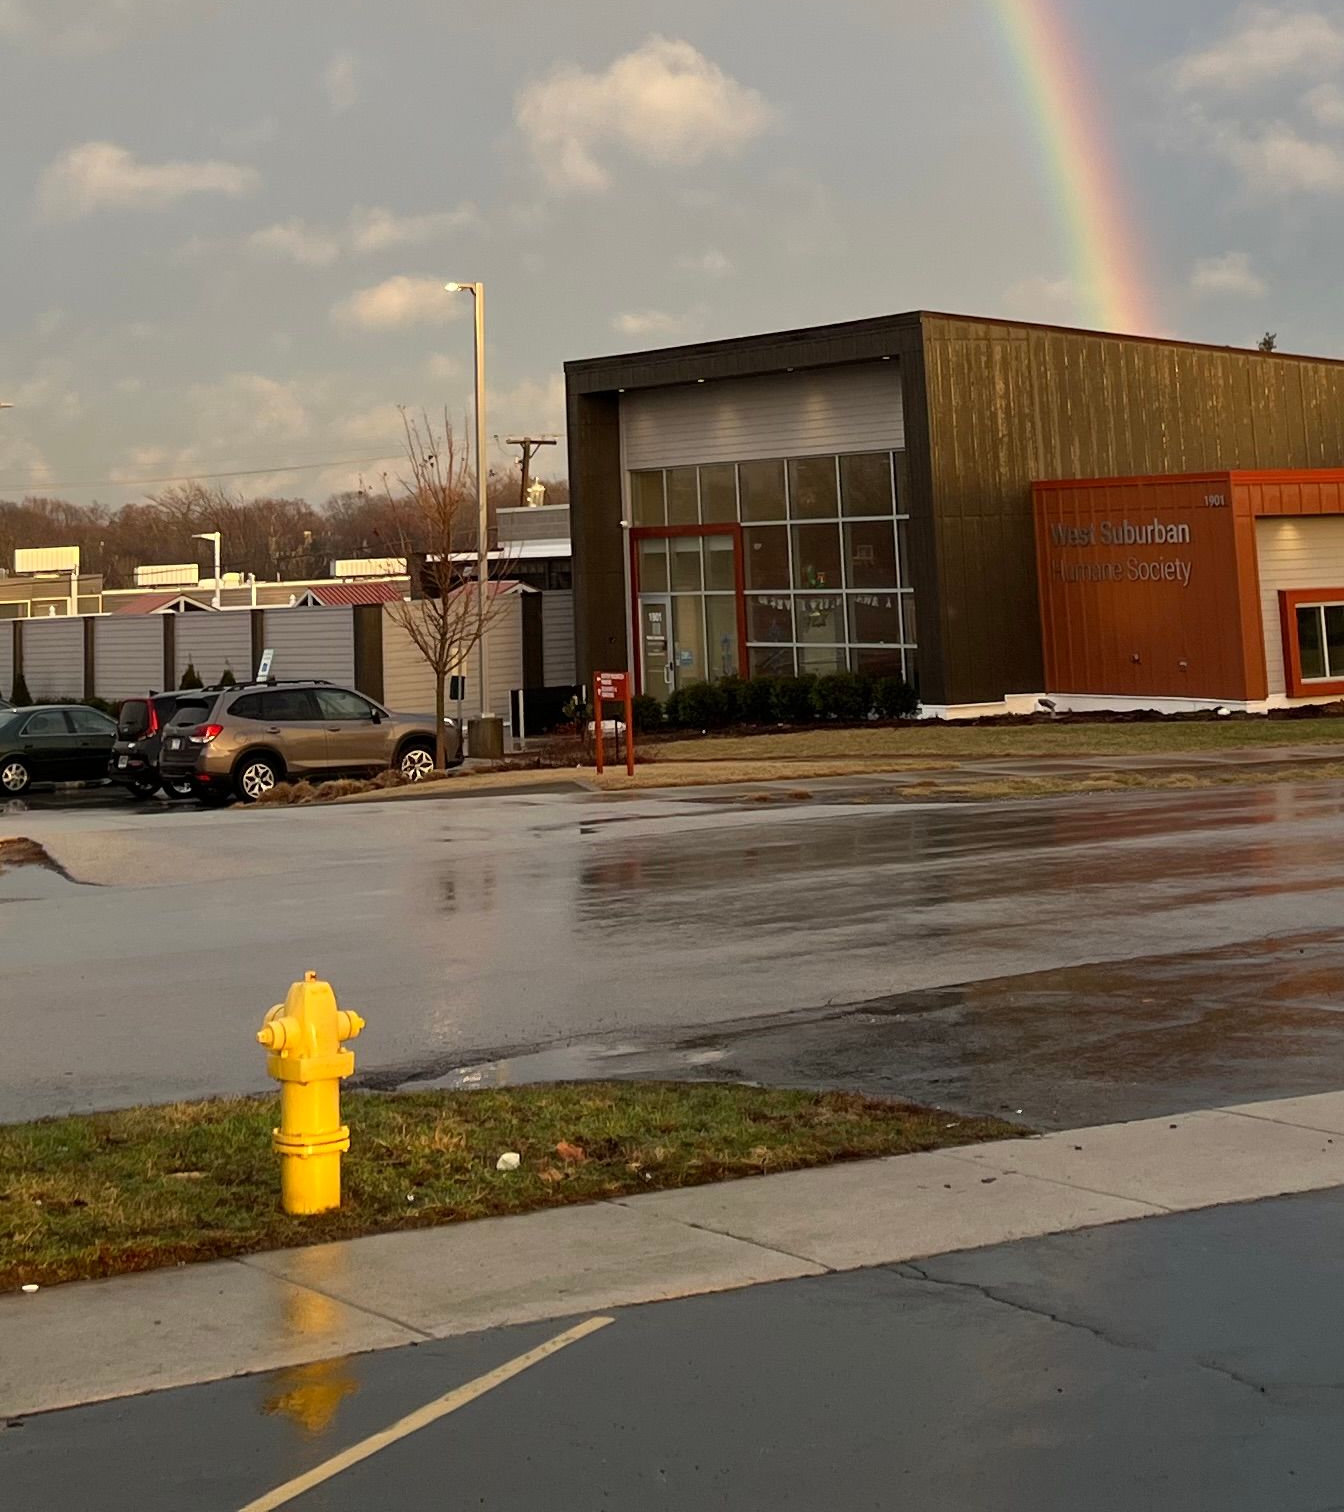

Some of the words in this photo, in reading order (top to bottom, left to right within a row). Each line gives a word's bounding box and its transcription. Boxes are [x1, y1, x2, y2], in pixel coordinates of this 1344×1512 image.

[1204, 494, 1226, 507] 1901
[1050, 521, 1097, 548] West
[1100, 517, 1191, 546] Suburban
[1052, 558, 1123, 584] Humane
[1126, 555, 1192, 588] Society
